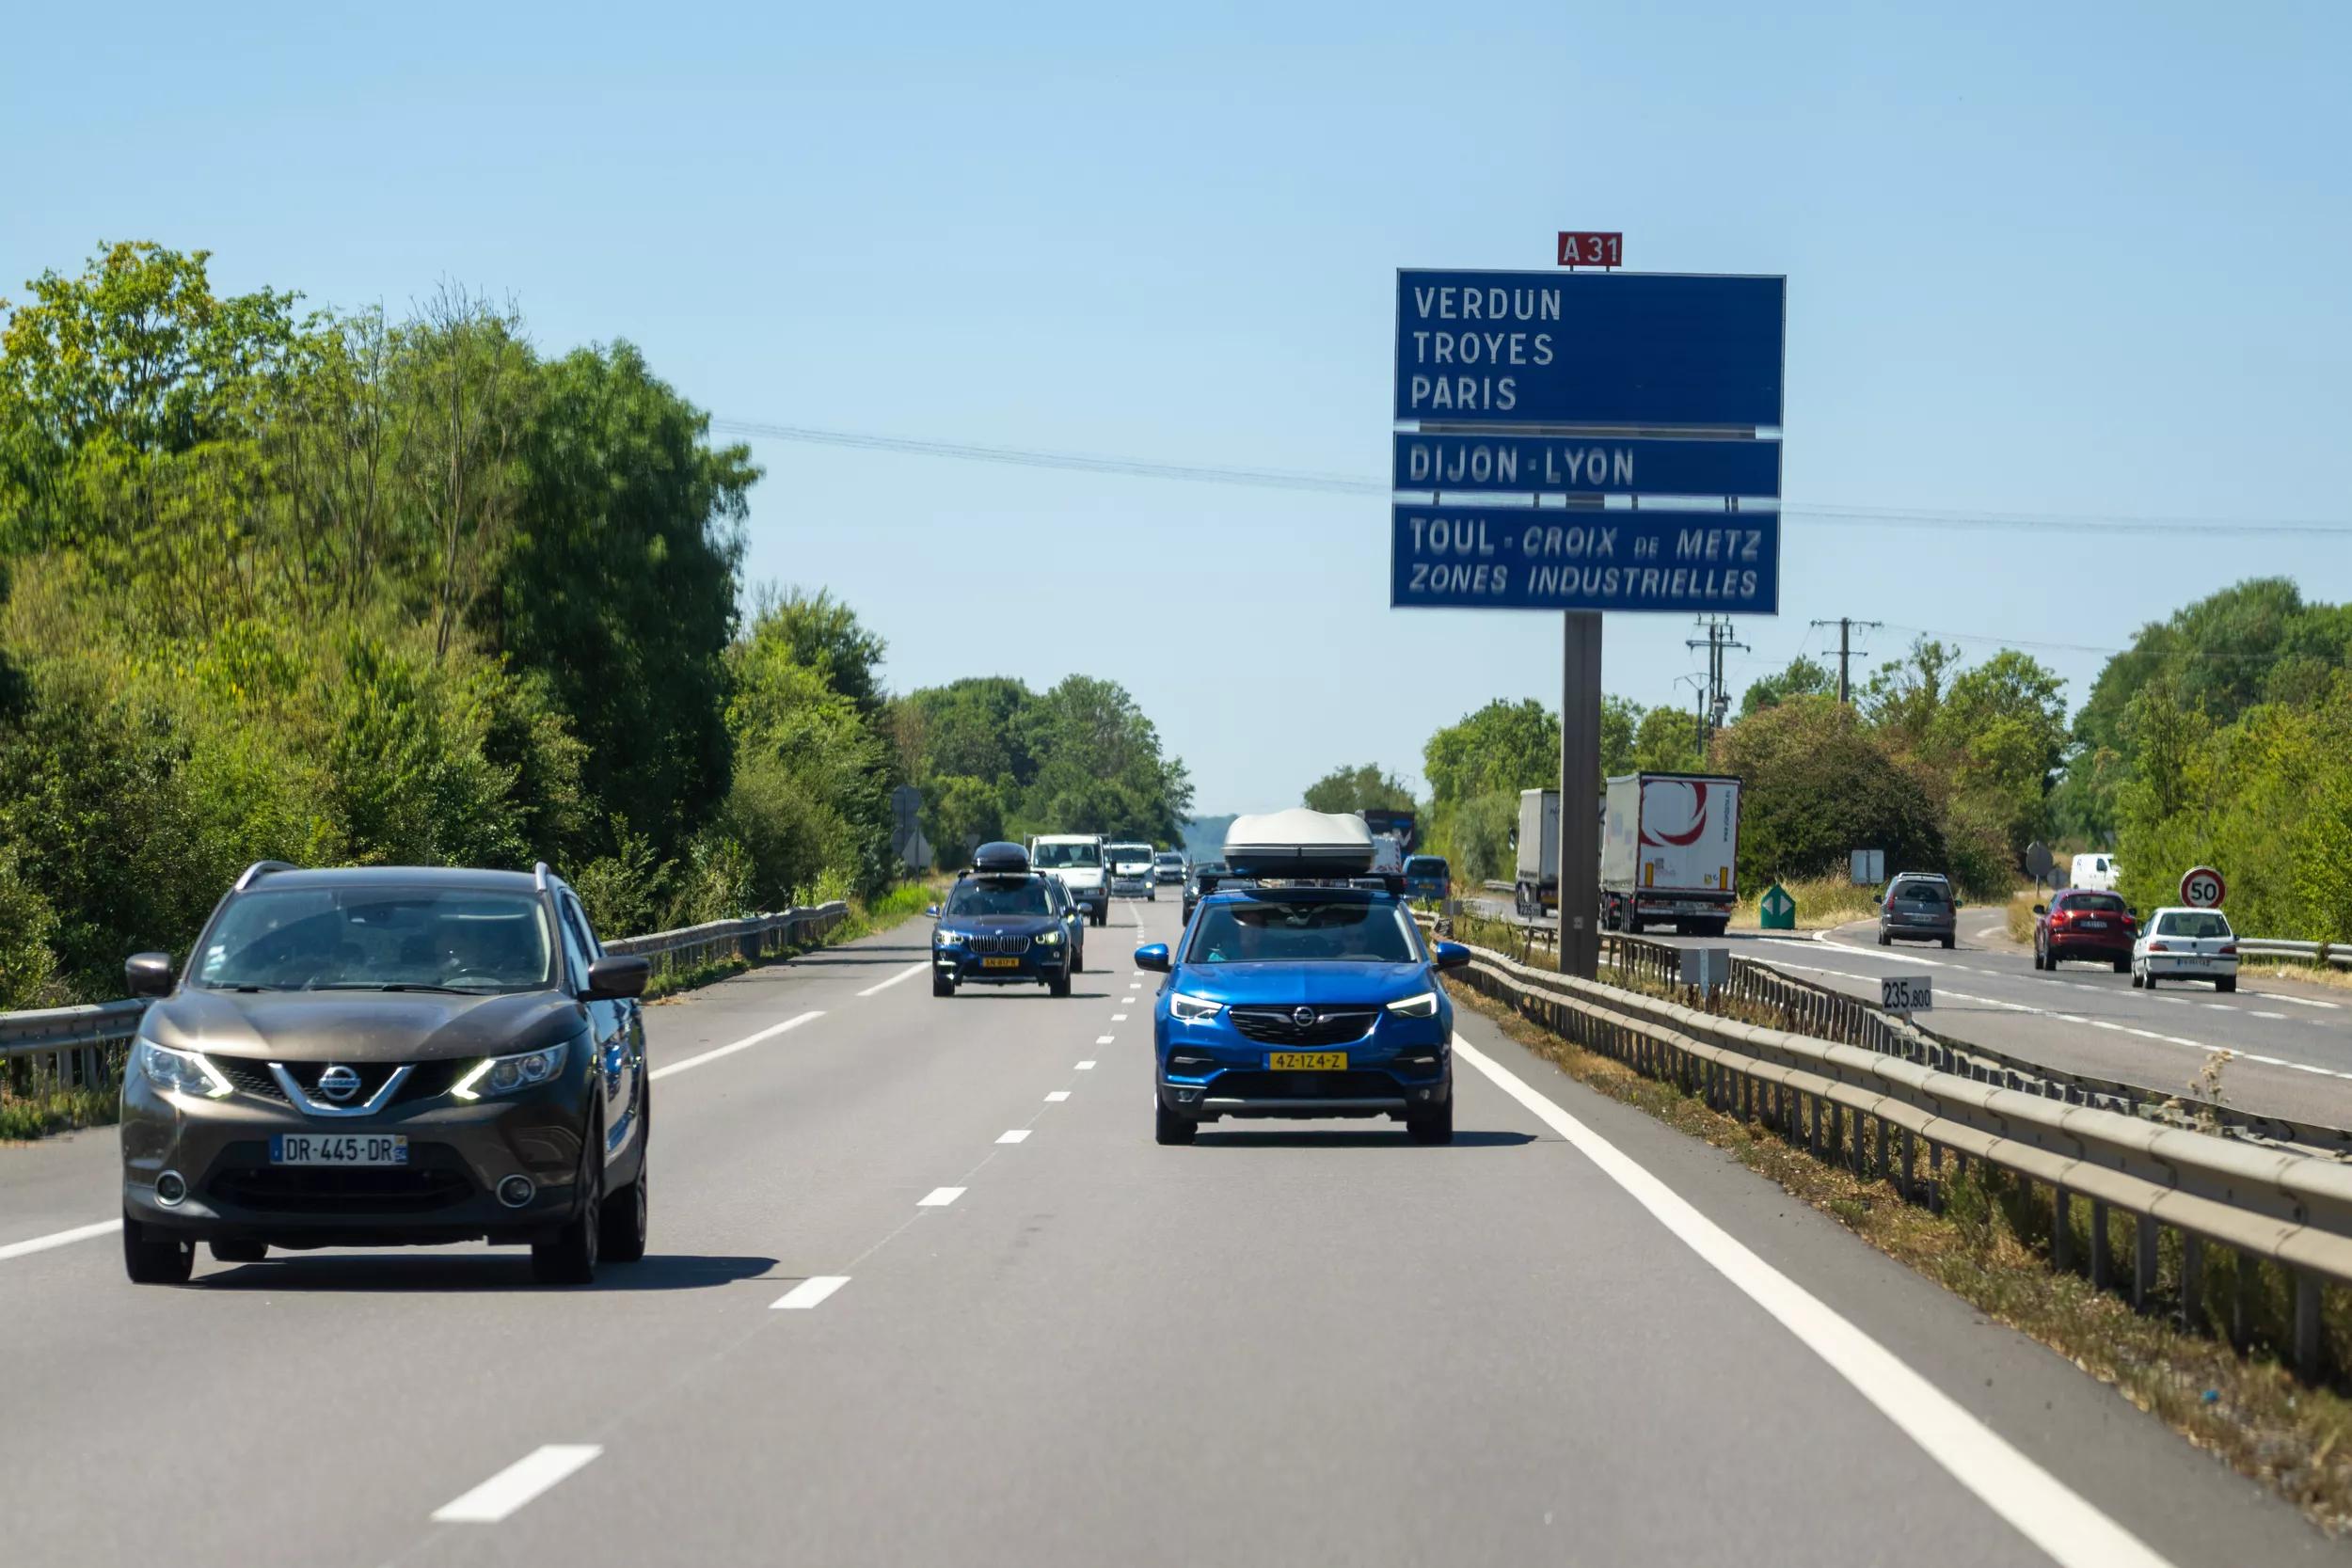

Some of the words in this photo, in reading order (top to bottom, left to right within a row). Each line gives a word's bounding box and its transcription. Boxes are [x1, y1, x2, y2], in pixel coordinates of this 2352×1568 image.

[1563, 235, 1580, 262] A
[1587, 236, 1618, 262] 31
[1414, 286, 1561, 320] VERDUN
[1413, 331, 1554, 365] TROYES
[1411, 374, 1518, 410] PARIS
[1410, 443, 1518, 483] DIJON
[1546, 446, 1634, 485] LYON
[1410, 517, 1495, 556] TOUL
[1522, 525, 1618, 559] CROIX
[1676, 529, 1762, 562] METZ
[1410, 563, 1508, 594] ZONES
[1528, 565, 1757, 599] INDUSTRIELLES
[2190, 882, 2217, 901] 50
[1883, 982, 1931, 1008] 235.800
[286, 1138, 392, 1161] DR-445-DR
